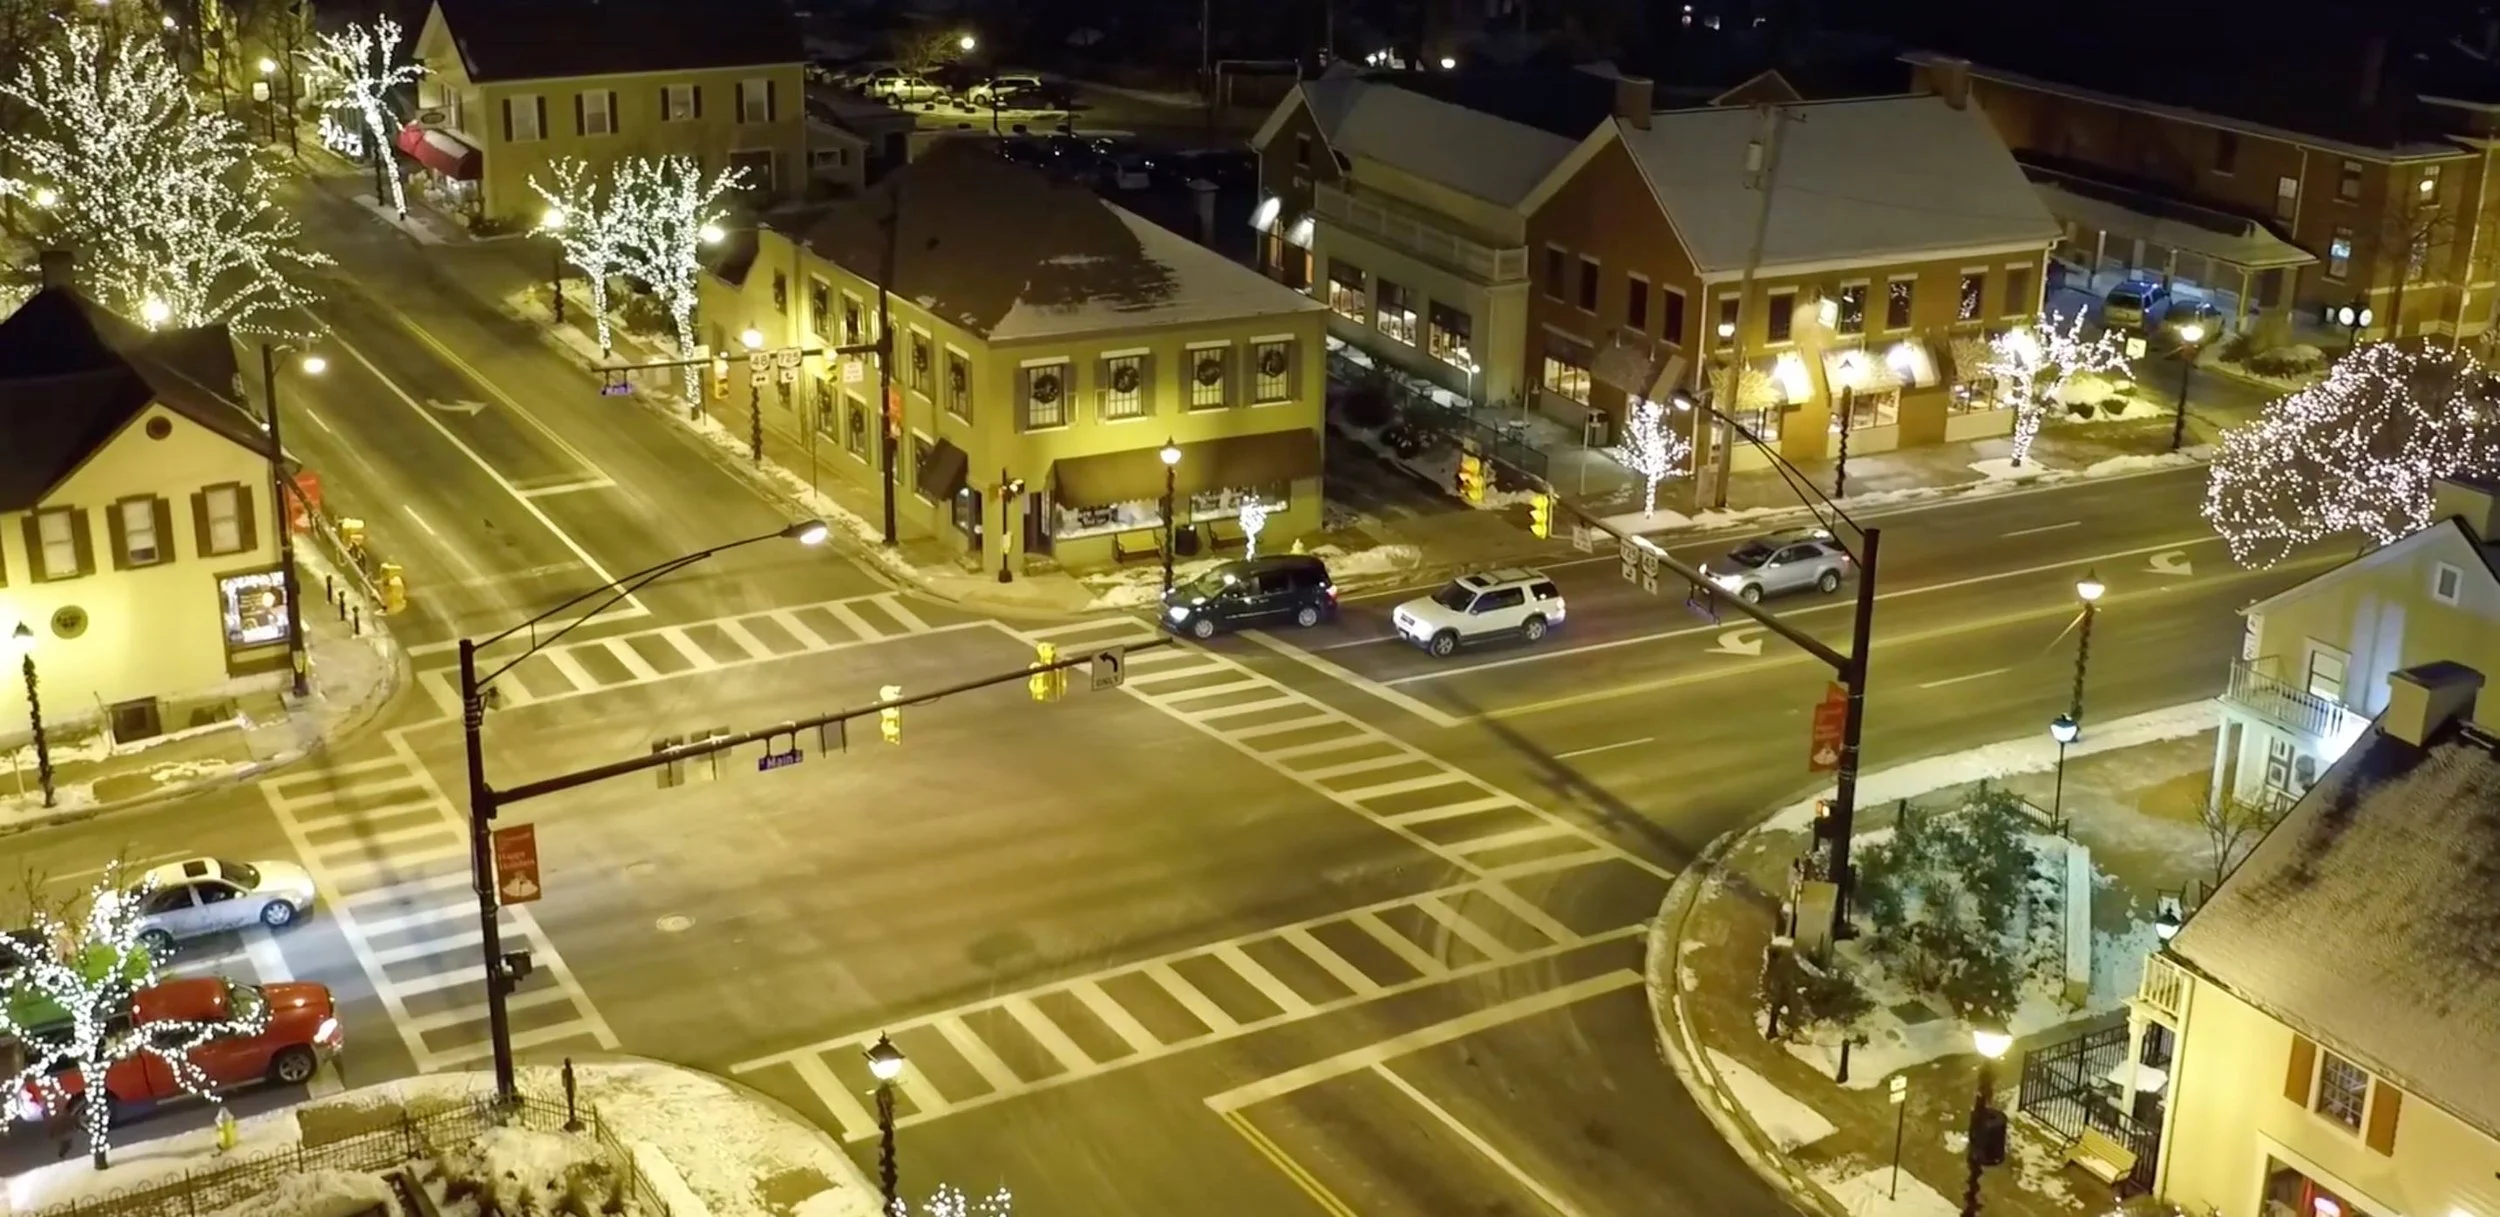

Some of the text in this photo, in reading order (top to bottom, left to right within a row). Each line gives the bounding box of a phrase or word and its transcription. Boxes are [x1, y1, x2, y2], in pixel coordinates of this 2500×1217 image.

[752, 355, 768, 366] 48
[779, 351, 800, 365] 725
[1096, 675, 1118, 686] ONLY
[766, 754, 793, 768] Main
